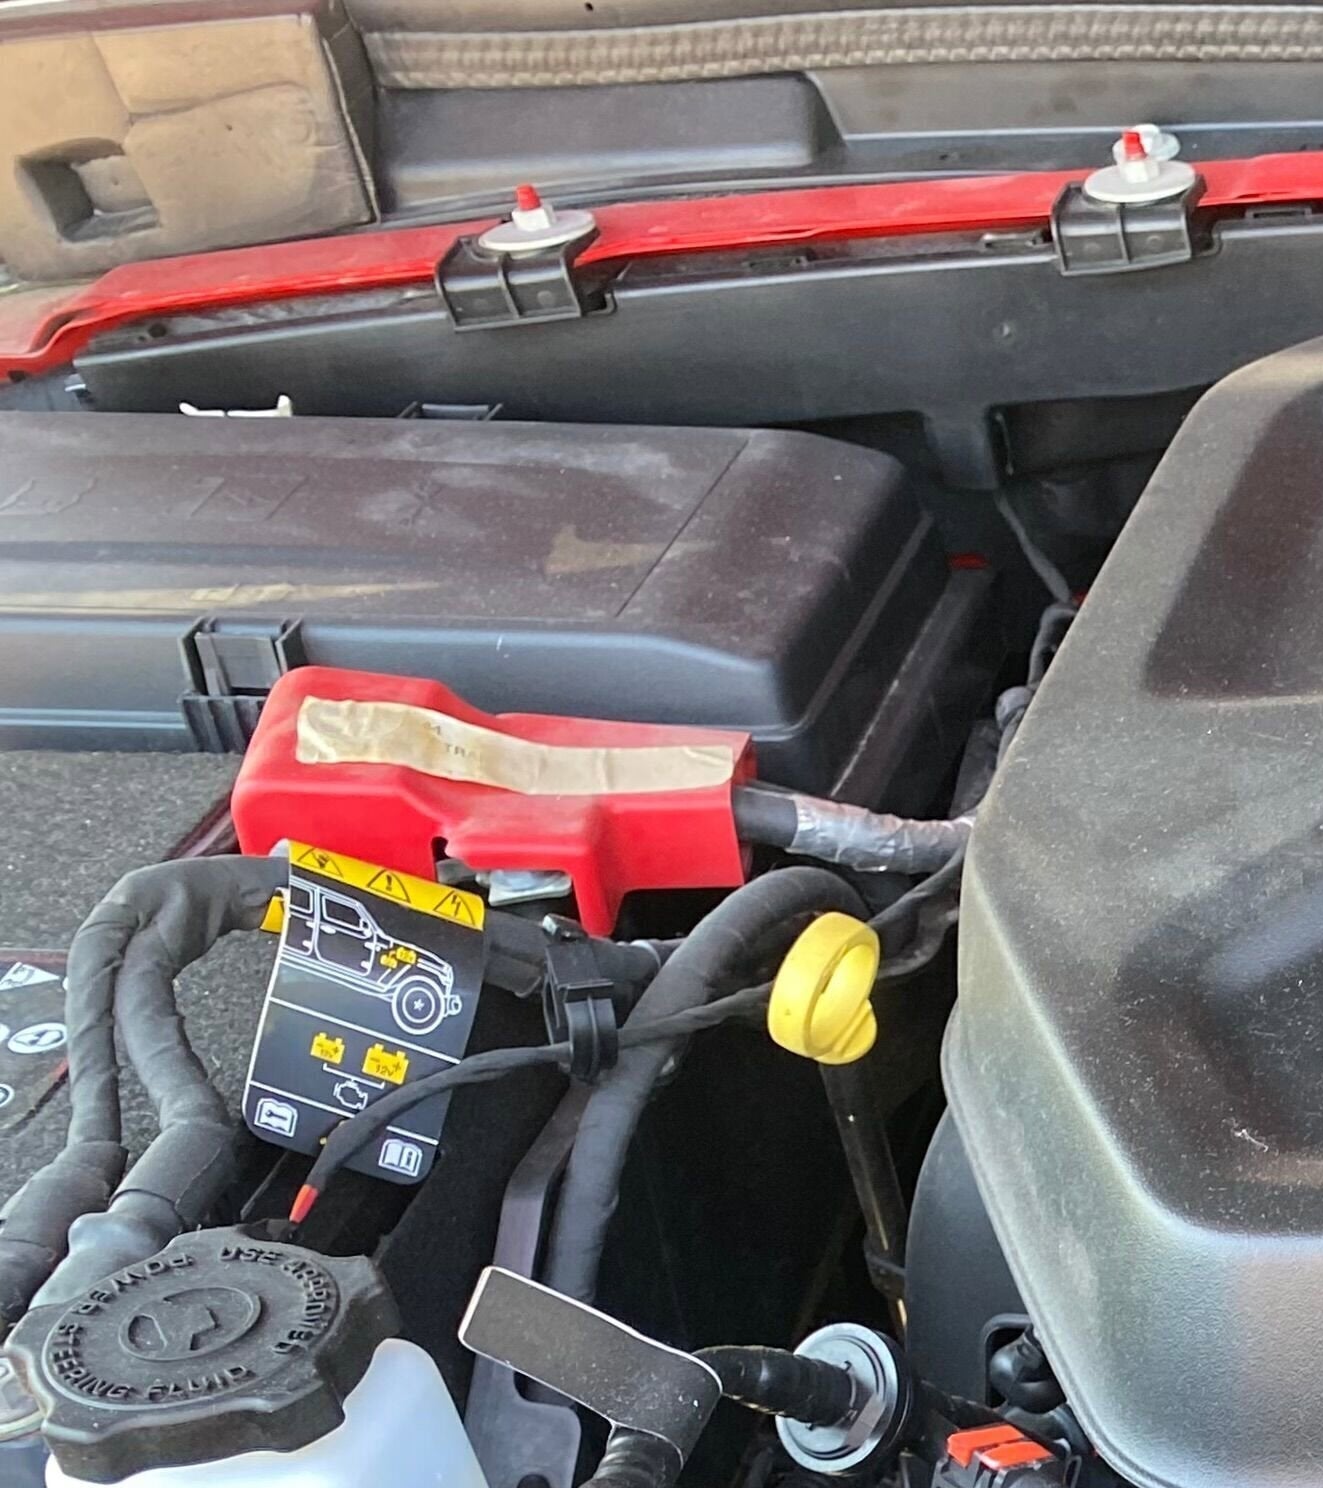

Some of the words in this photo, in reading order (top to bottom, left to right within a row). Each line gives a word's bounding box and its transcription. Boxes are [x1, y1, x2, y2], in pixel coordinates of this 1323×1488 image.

[71, 1252, 195, 1316] POWER
[218, 1246, 280, 1267] USE
[270, 1258, 328, 1356] APPROVED
[51, 1322, 135, 1398] STEERING
[146, 1363, 254, 1400] FLUID
